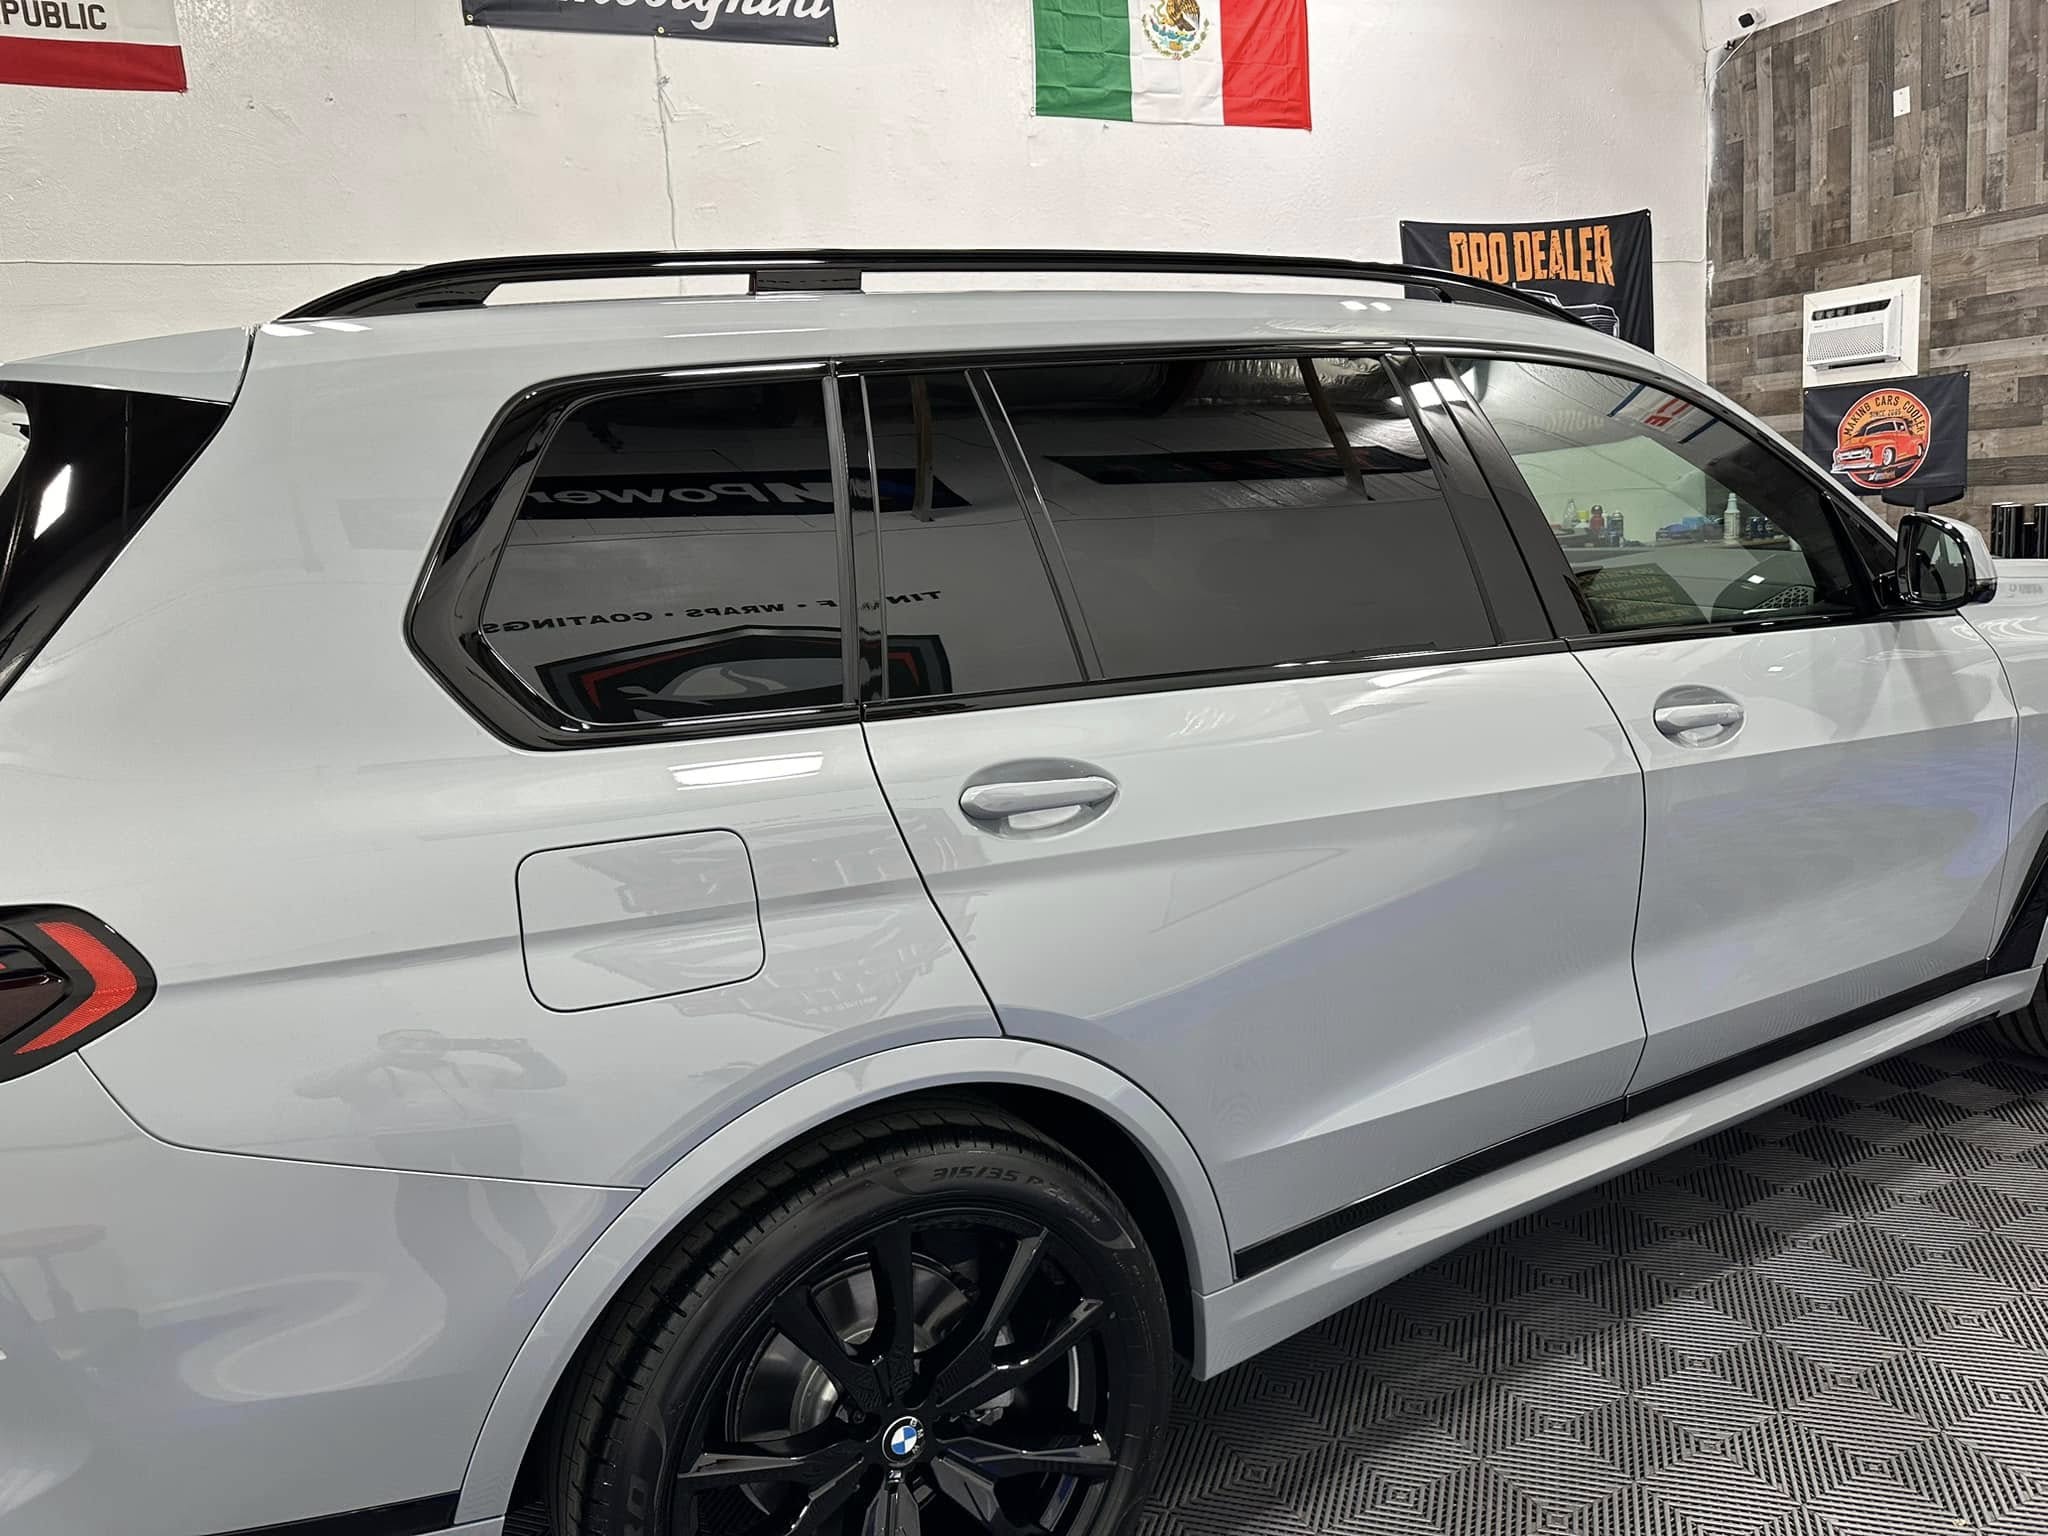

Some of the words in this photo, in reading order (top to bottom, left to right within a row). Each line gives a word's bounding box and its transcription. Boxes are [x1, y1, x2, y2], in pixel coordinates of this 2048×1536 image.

[0, 0, 107, 30] PUBLIC
[1449, 231, 1509, 284] PRO
[1513, 225, 1615, 287] DEALER
[1844, 402, 1871, 436] MAKING
[1875, 395, 1900, 407] CARS
[1903, 401, 1926, 433] COOLER
[930, 1166, 1023, 1182] 315/35
